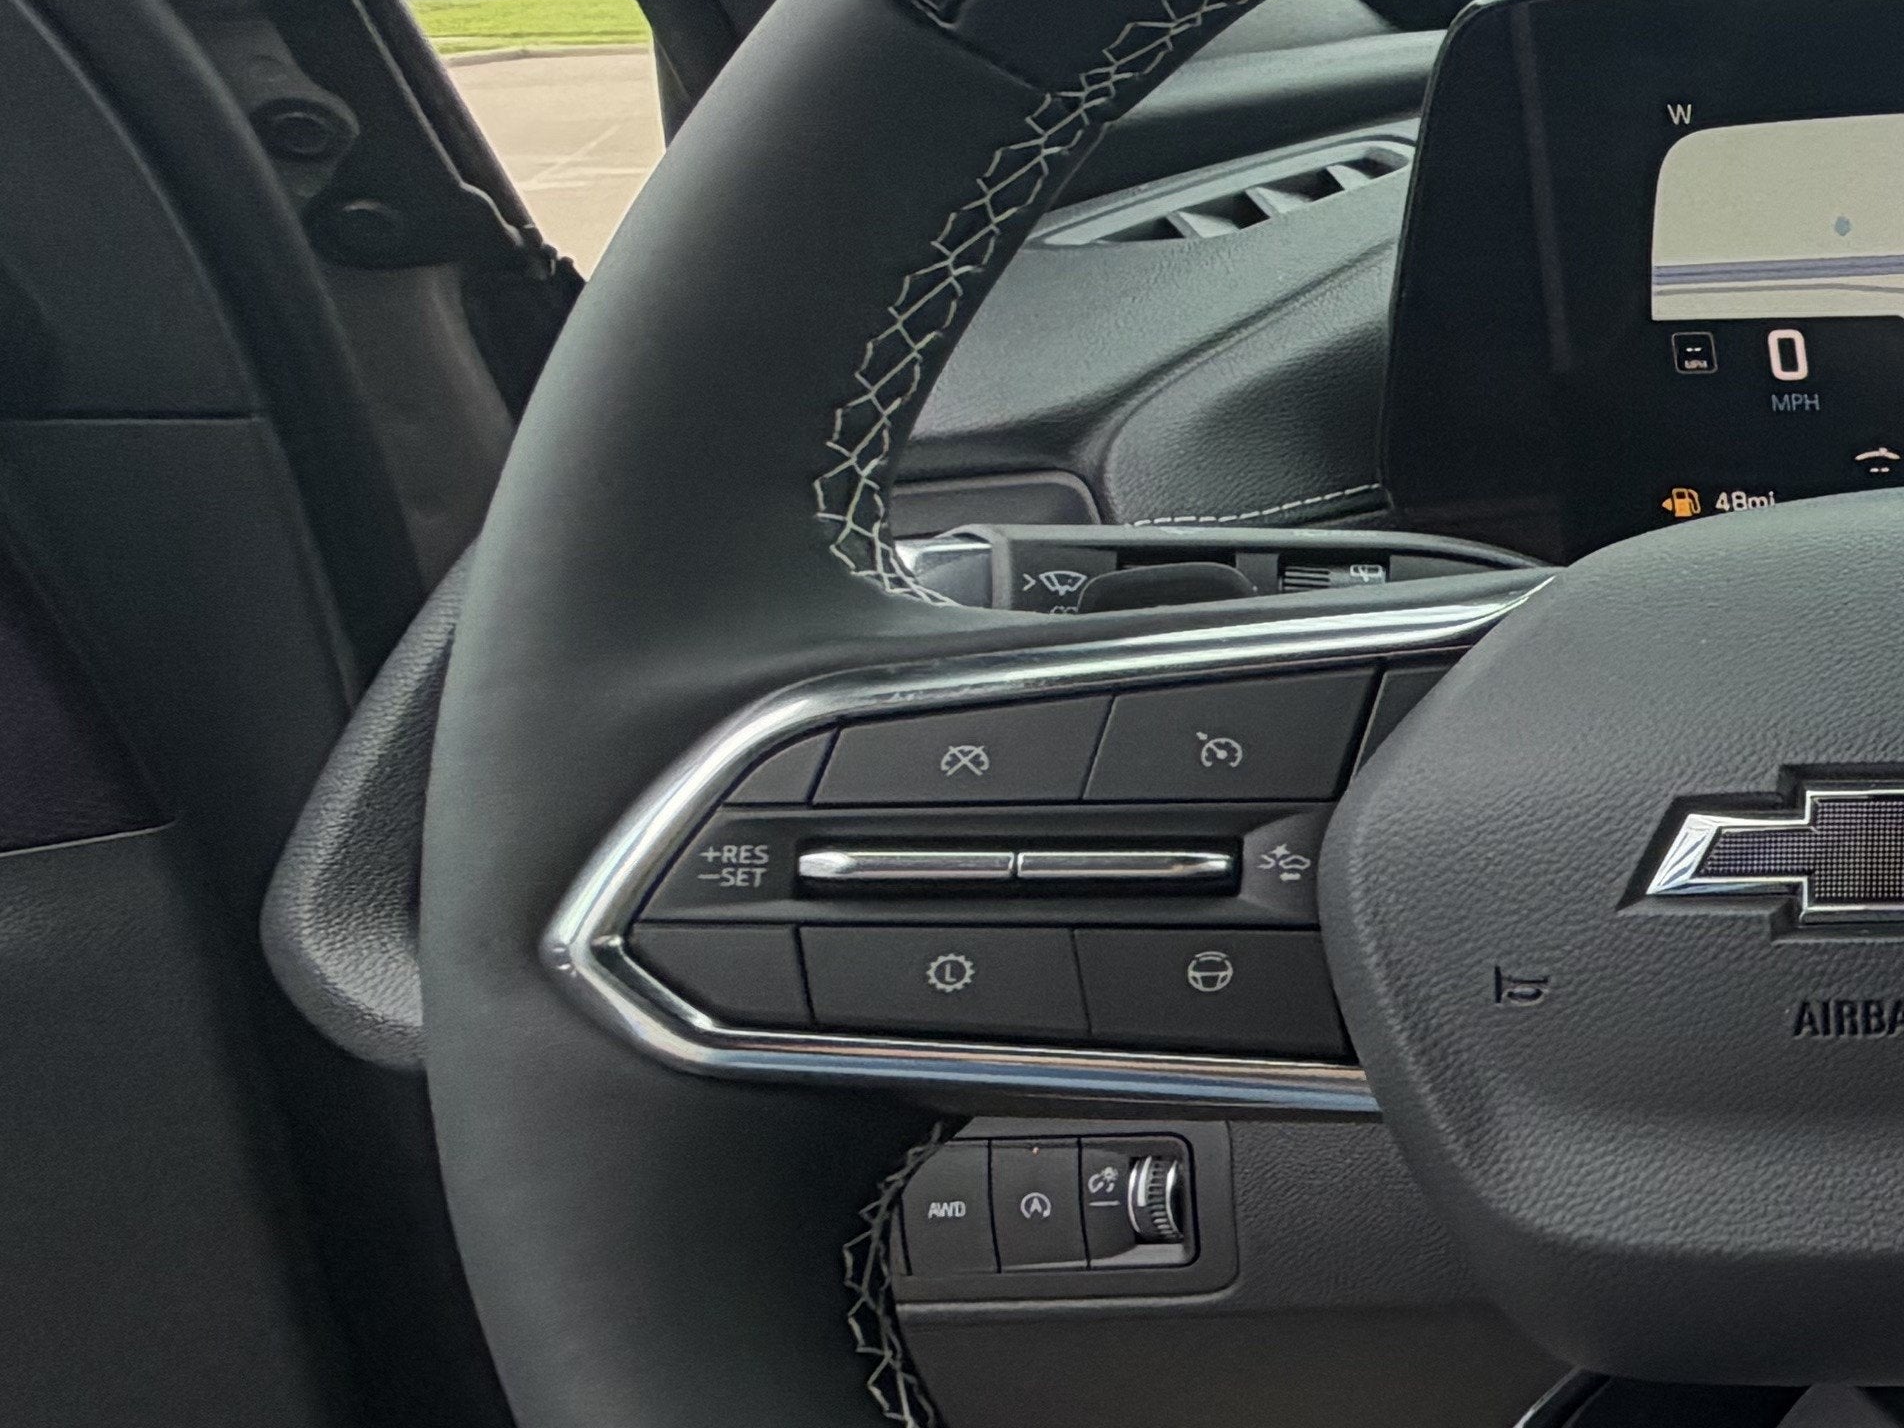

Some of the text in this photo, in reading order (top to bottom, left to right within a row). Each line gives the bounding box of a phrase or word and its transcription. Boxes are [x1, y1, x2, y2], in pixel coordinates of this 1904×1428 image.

[1666, 103, 1693, 125] W
[1767, 329, 1808, 381] 0
[1771, 393, 1820, 412] MPH
[927, 1201, 966, 1219] AWD
